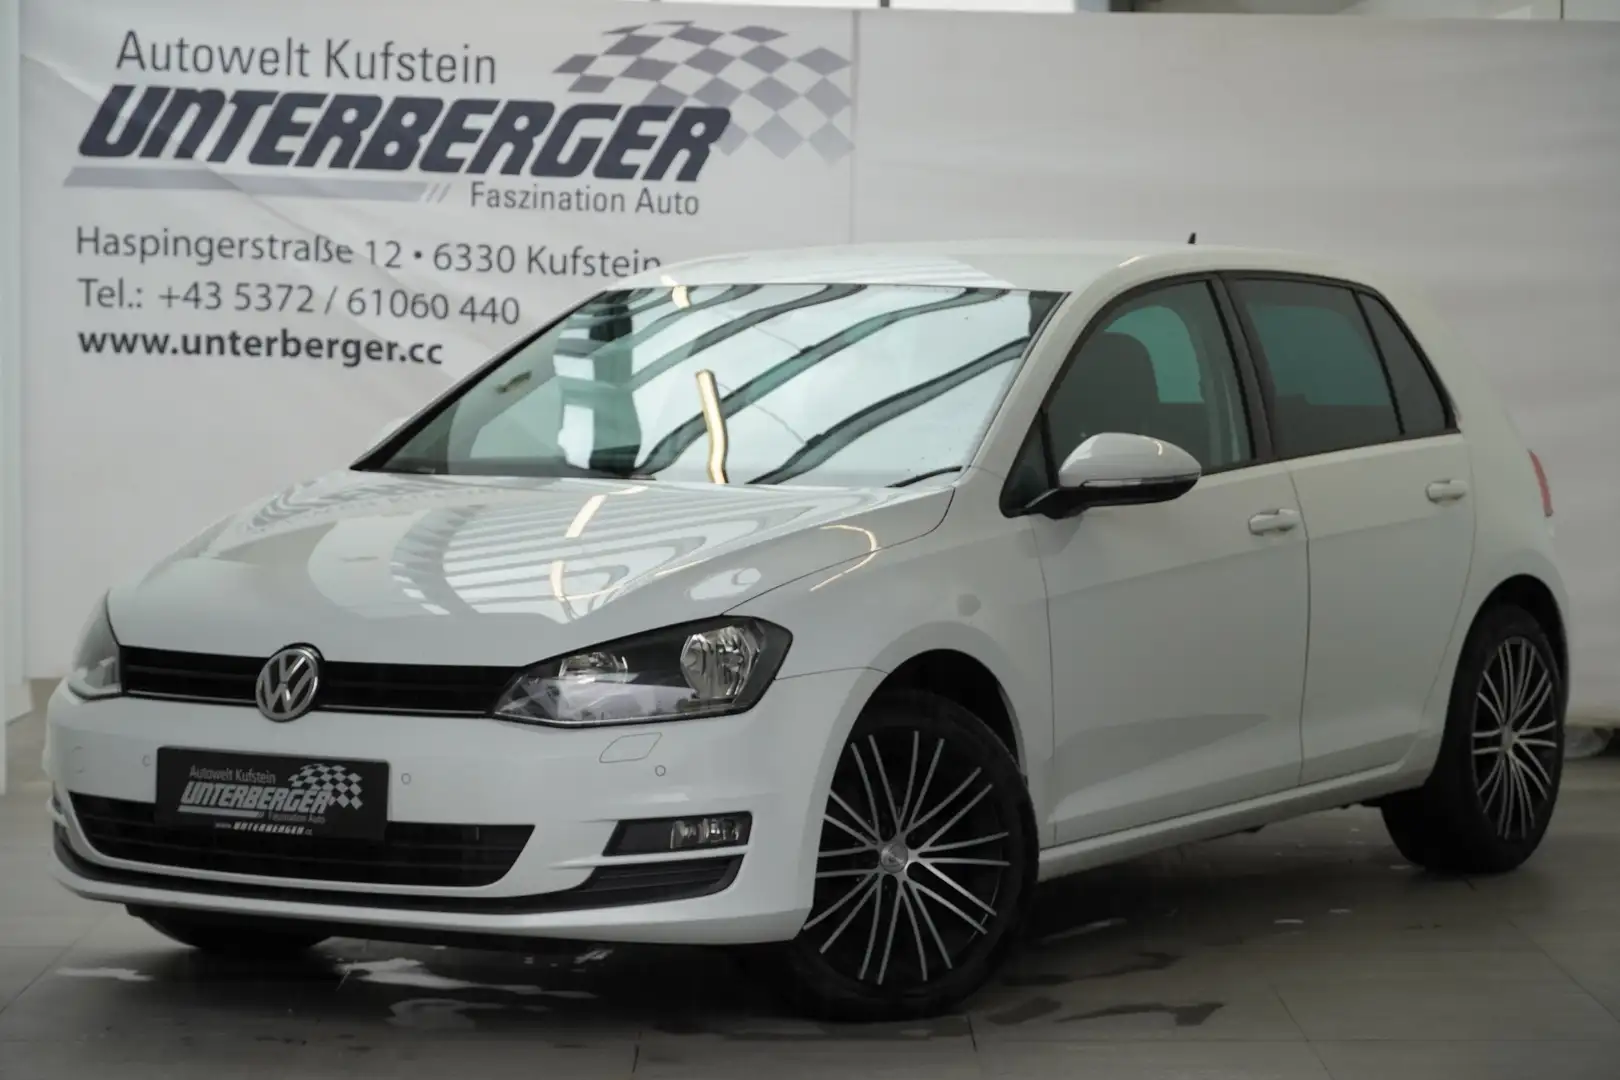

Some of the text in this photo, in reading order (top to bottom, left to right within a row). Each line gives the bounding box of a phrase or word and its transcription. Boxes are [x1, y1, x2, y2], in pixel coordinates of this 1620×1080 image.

[116, 30, 496, 84] Autowelt Kufstein
[78, 84, 731, 182] UNTERBERGER
[470, 181, 699, 216] Faszination Auto
[76, 226, 354, 267] Haspingerstraße
[365, 240, 402, 269] 12
[433, 243, 516, 274] 6330
[77, 277, 143, 309] Tel.:
[159, 281, 222, 311] +43
[234, 283, 315, 313] 5372
[347, 287, 450, 320] 61060
[459, 296, 520, 325] 440
[78, 328, 443, 367] www.unterberger.cc
[189, 765, 233, 781] Autowelt
[180, 780, 332, 815] UNTERBERGER
